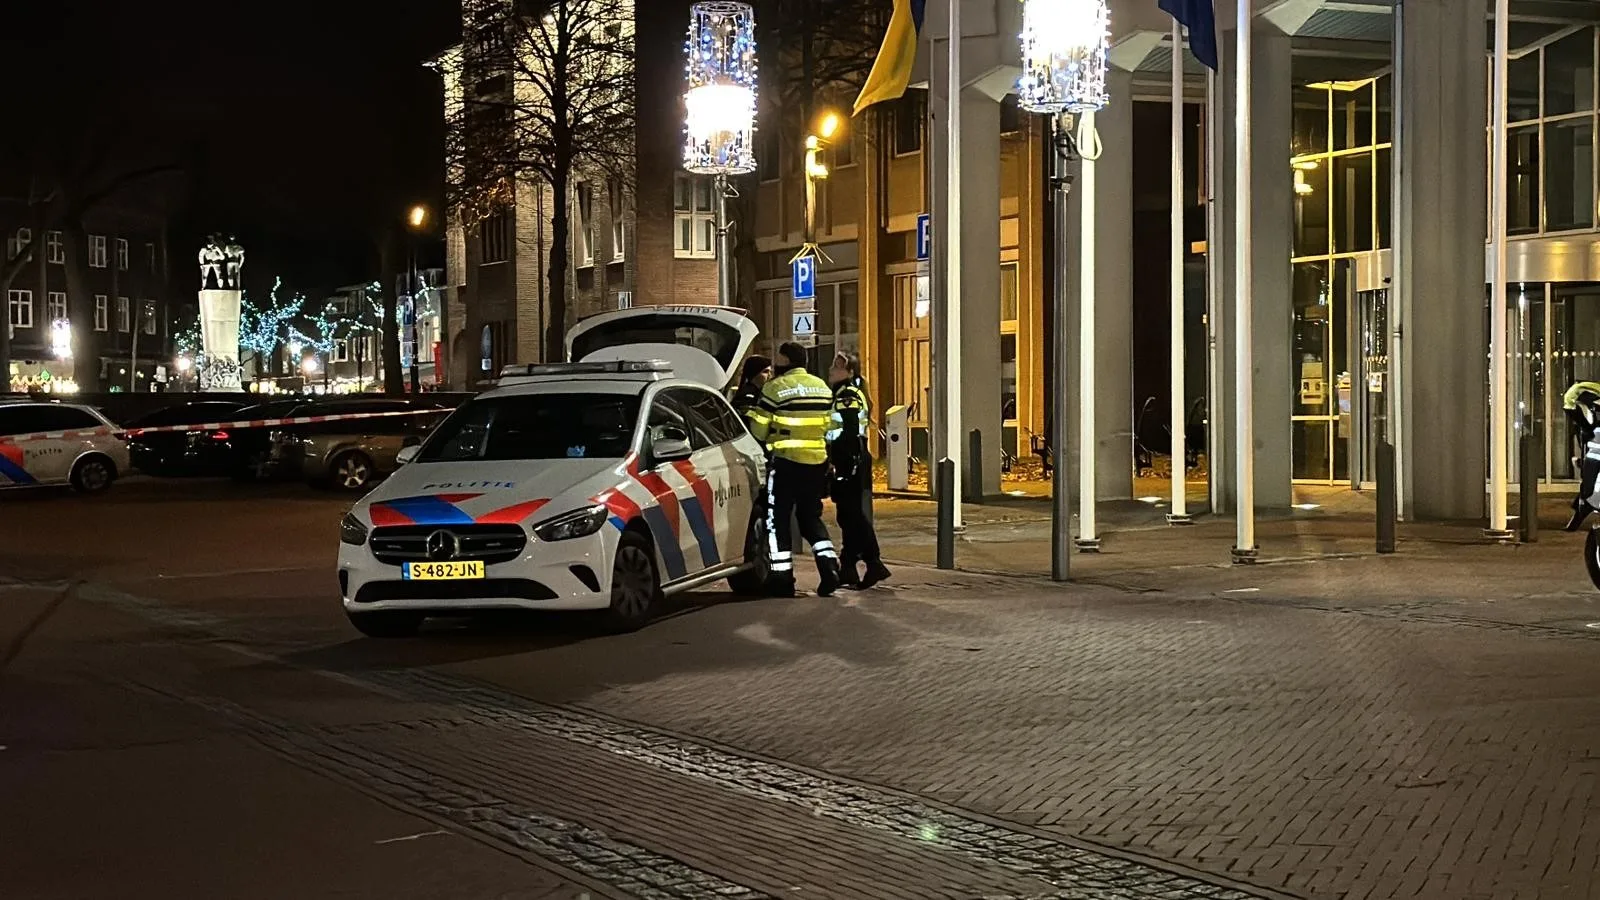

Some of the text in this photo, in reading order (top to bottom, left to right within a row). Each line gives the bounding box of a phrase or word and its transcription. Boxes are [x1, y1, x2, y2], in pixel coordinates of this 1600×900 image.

[798, 261, 809, 293] P
[422, 481, 515, 490] POLITIE
[413, 563, 477, 577] S-482-JN
